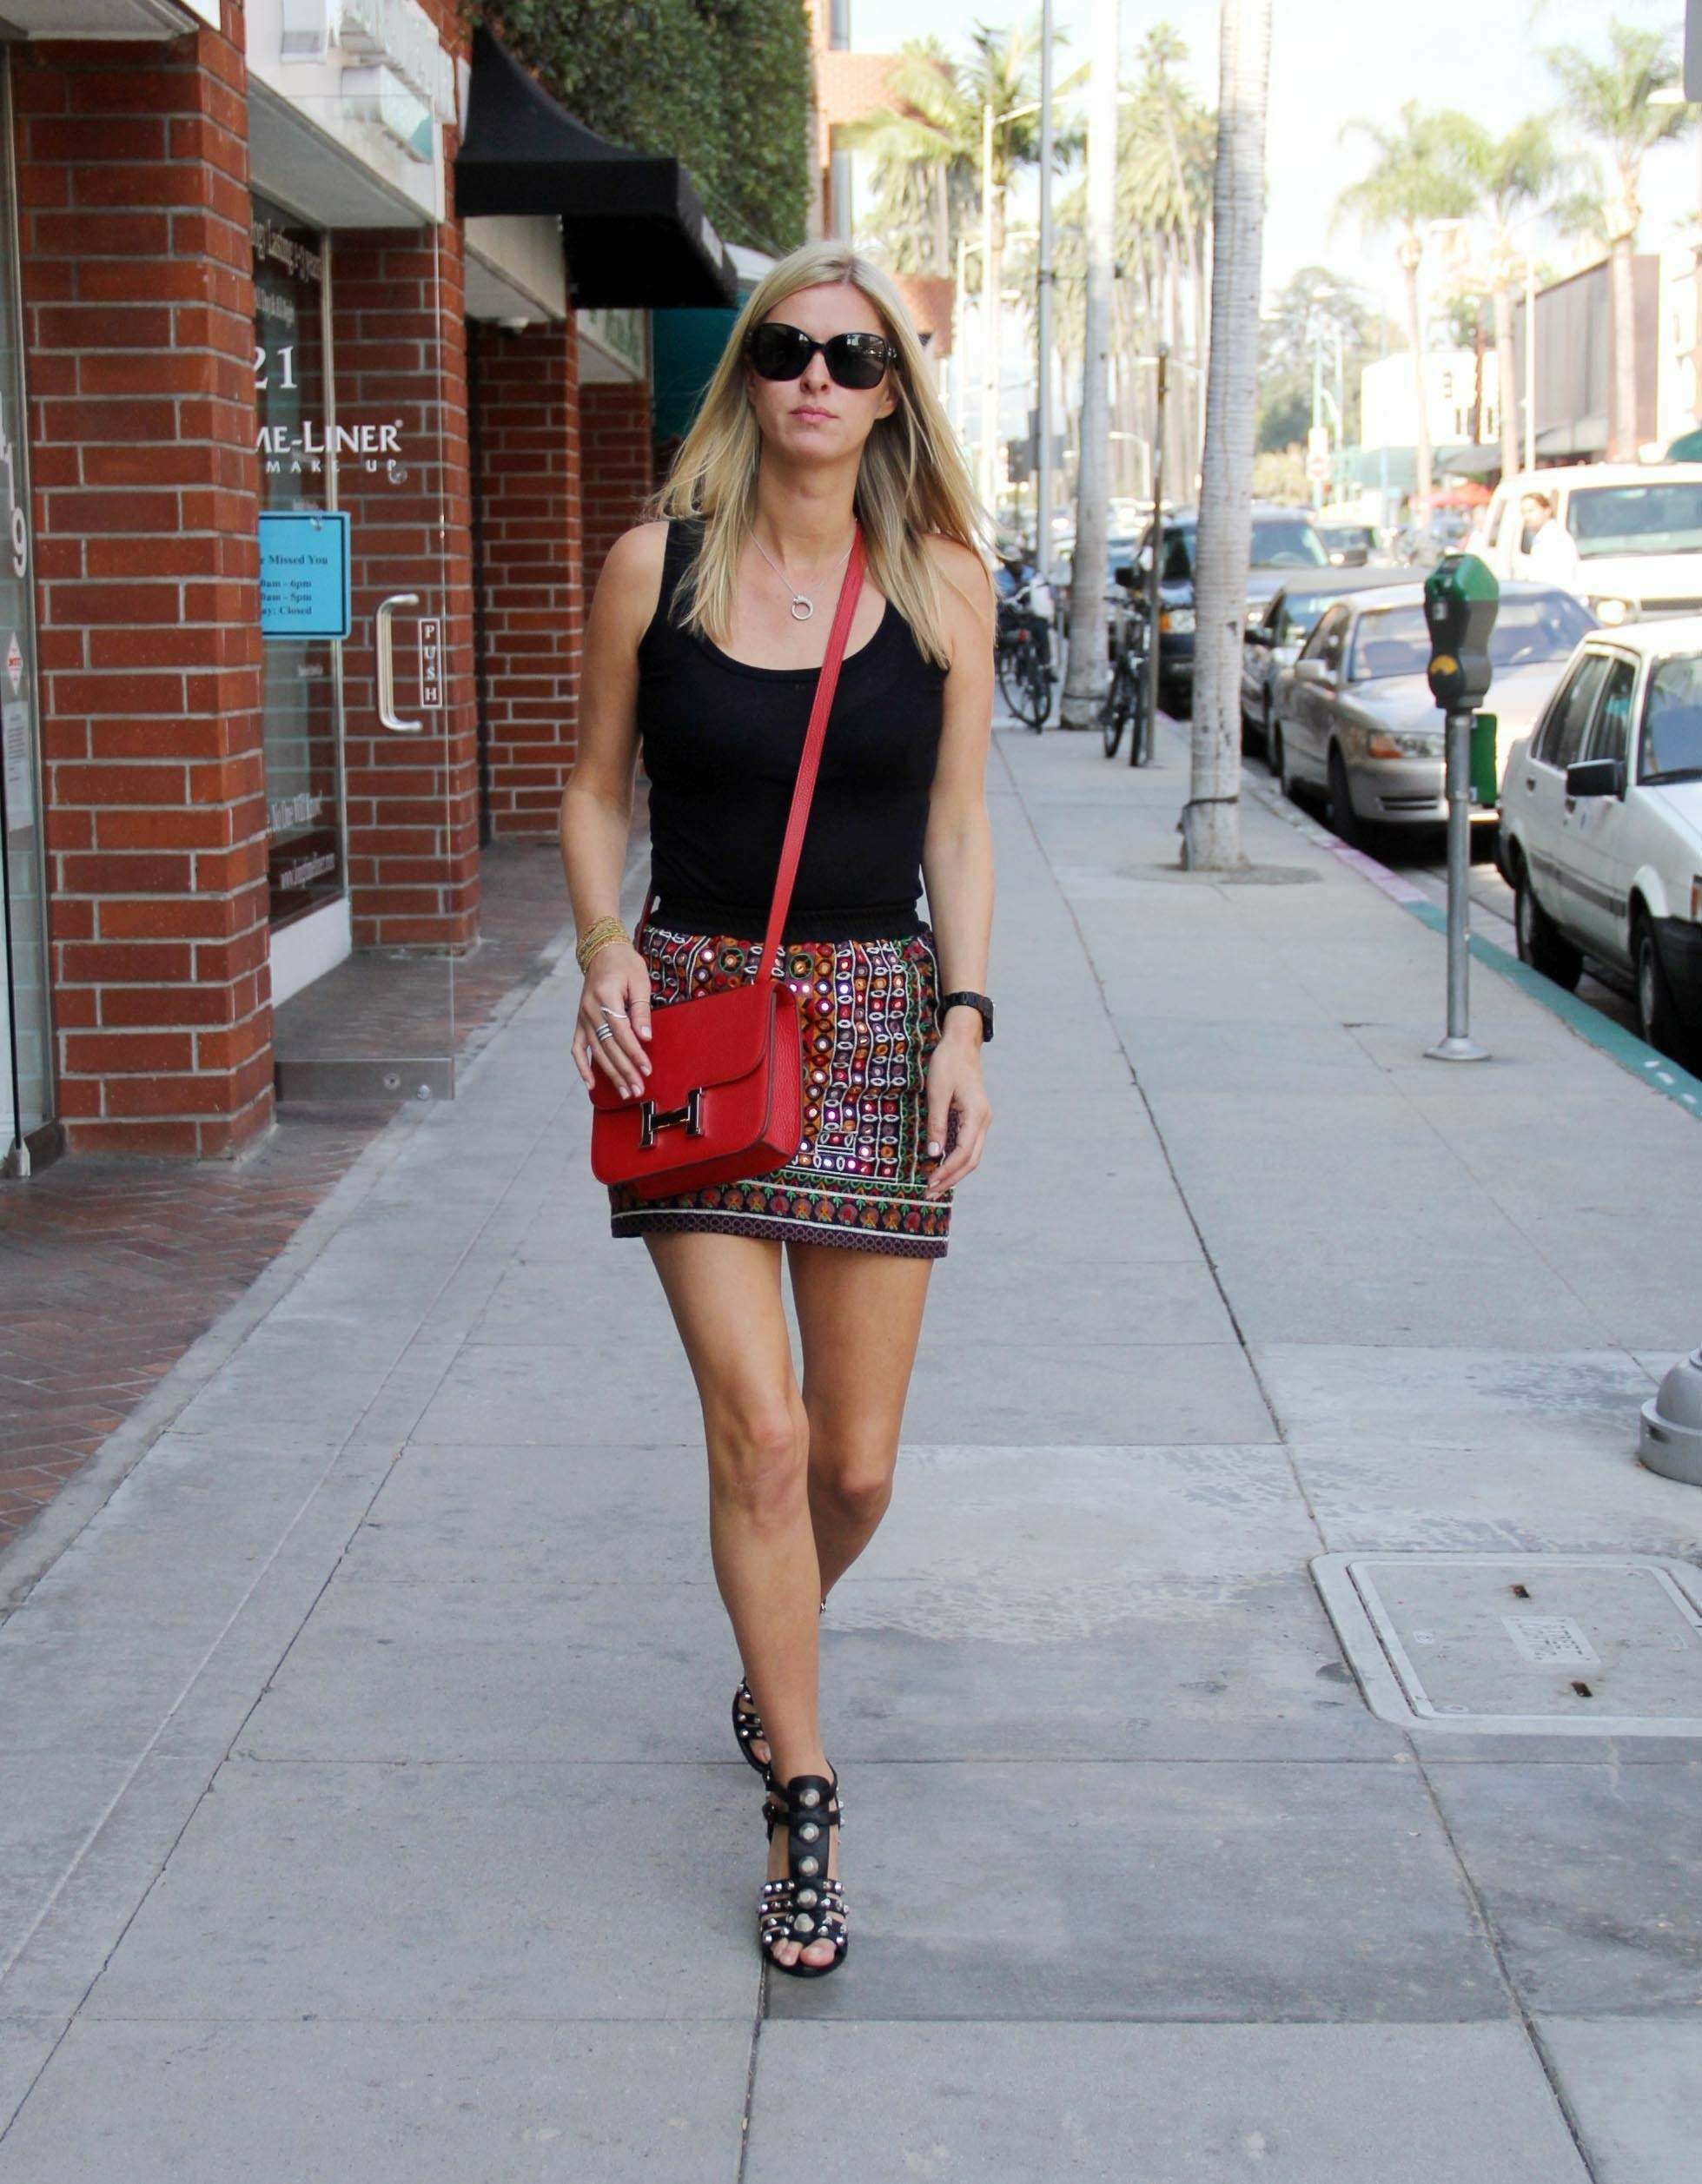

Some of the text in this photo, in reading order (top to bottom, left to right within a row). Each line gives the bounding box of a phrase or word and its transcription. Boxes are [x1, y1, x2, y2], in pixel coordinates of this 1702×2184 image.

[268, 555, 305, 566] Missed
[308, 556, 328, 565] You
[279, 606, 313, 615] Closed
[423, 625, 437, 702] PUSH
